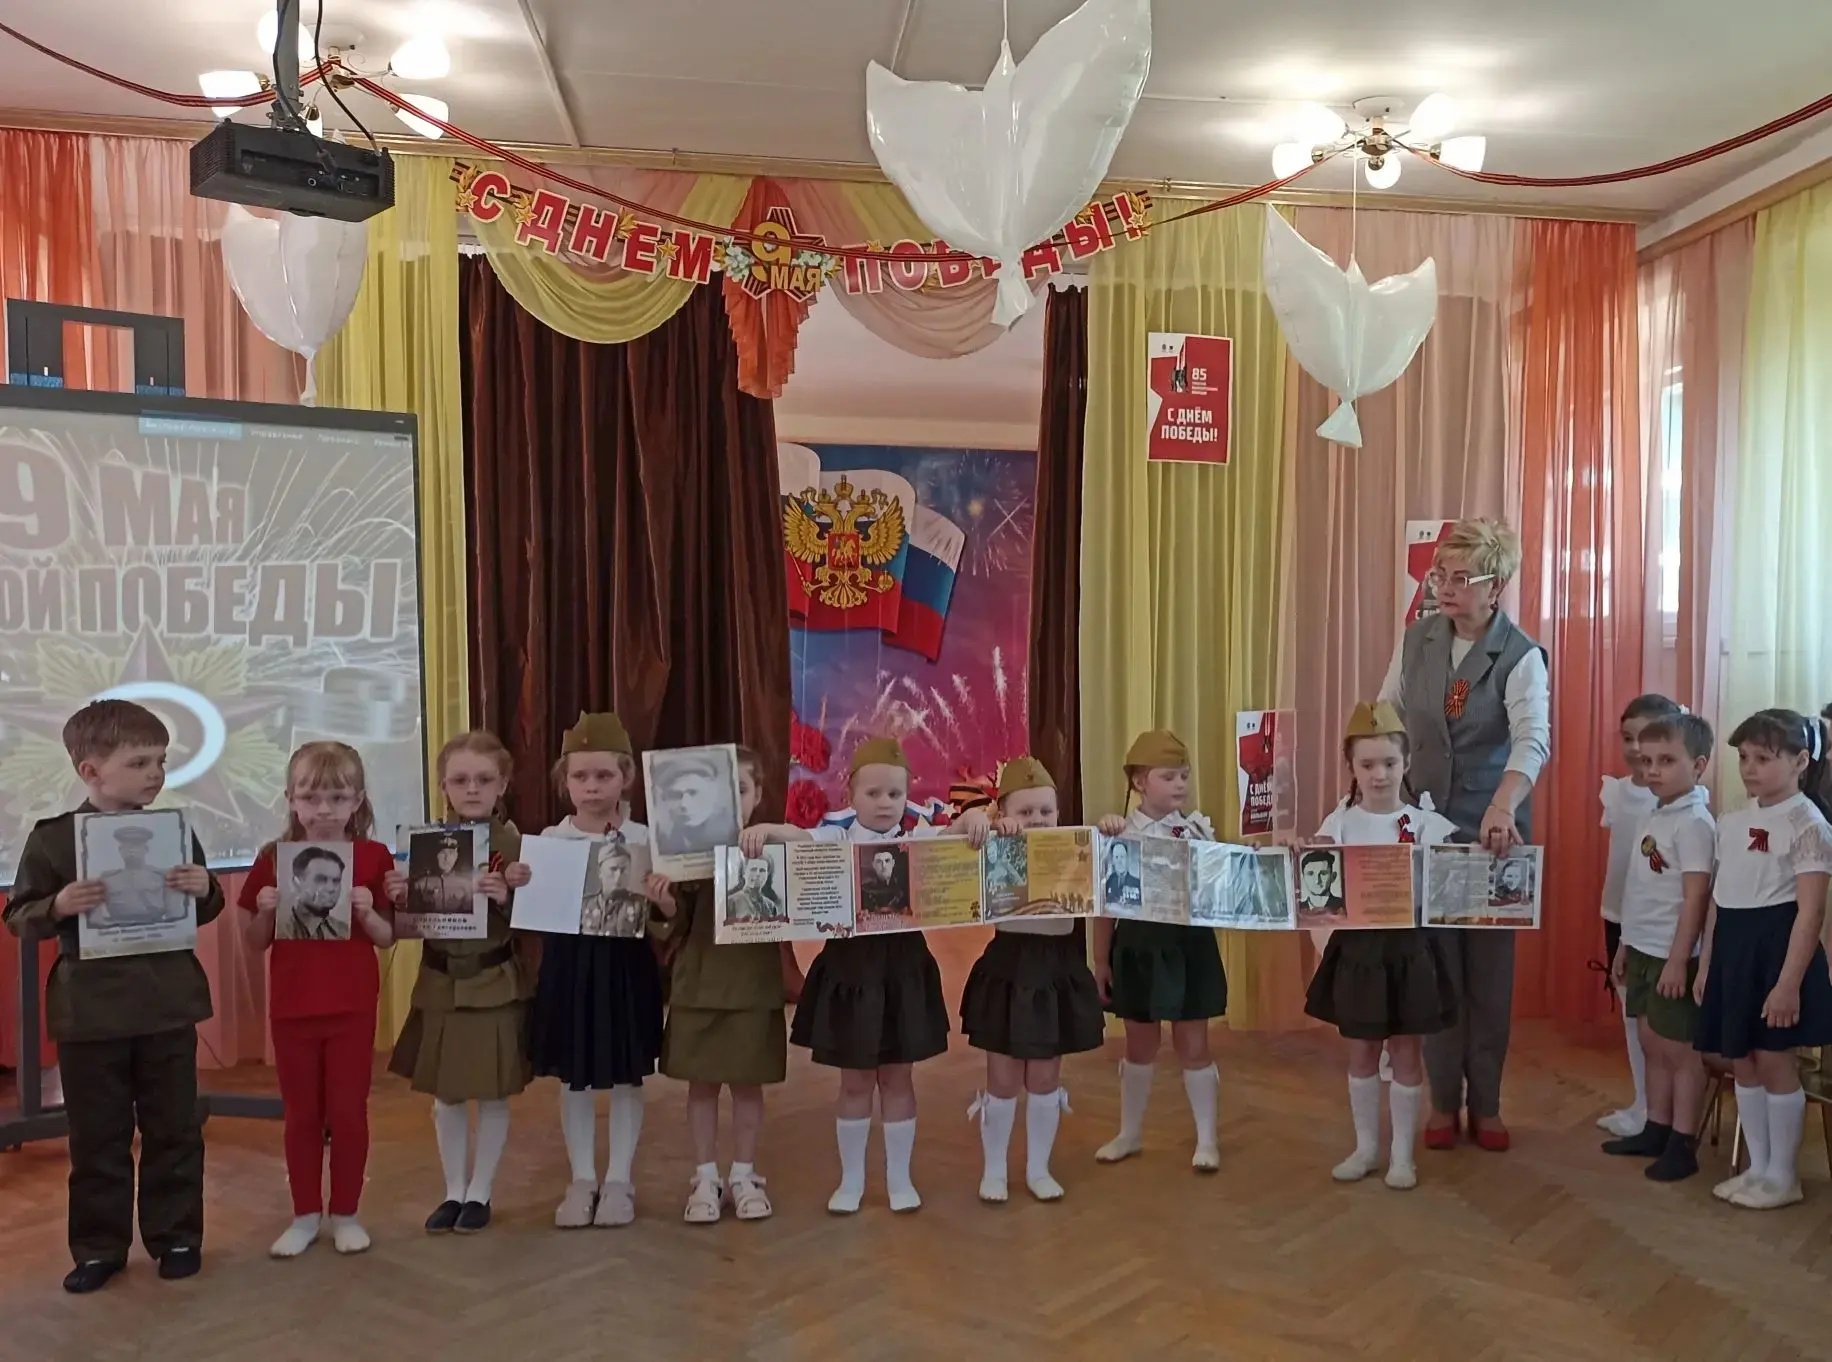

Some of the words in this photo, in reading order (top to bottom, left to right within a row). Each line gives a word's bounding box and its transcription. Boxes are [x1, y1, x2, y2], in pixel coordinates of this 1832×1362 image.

[469, 170, 511, 223] С
[515, 188, 716, 285] ДНЕМ
[752, 222, 792, 283] 9
[770, 263, 822, 293] МАЯ
[1192, 367, 1207, 381] 85
[1161, 425, 1218, 443] ПОБЕДЫ!
[1167, 408, 1175, 422] С
[1177, 406, 1212, 425] ДНЁМ
[0, 442, 70, 550] 9
[99, 460, 247, 548] МАЯ
[77, 559, 400, 650] ПОБЕДЫ
